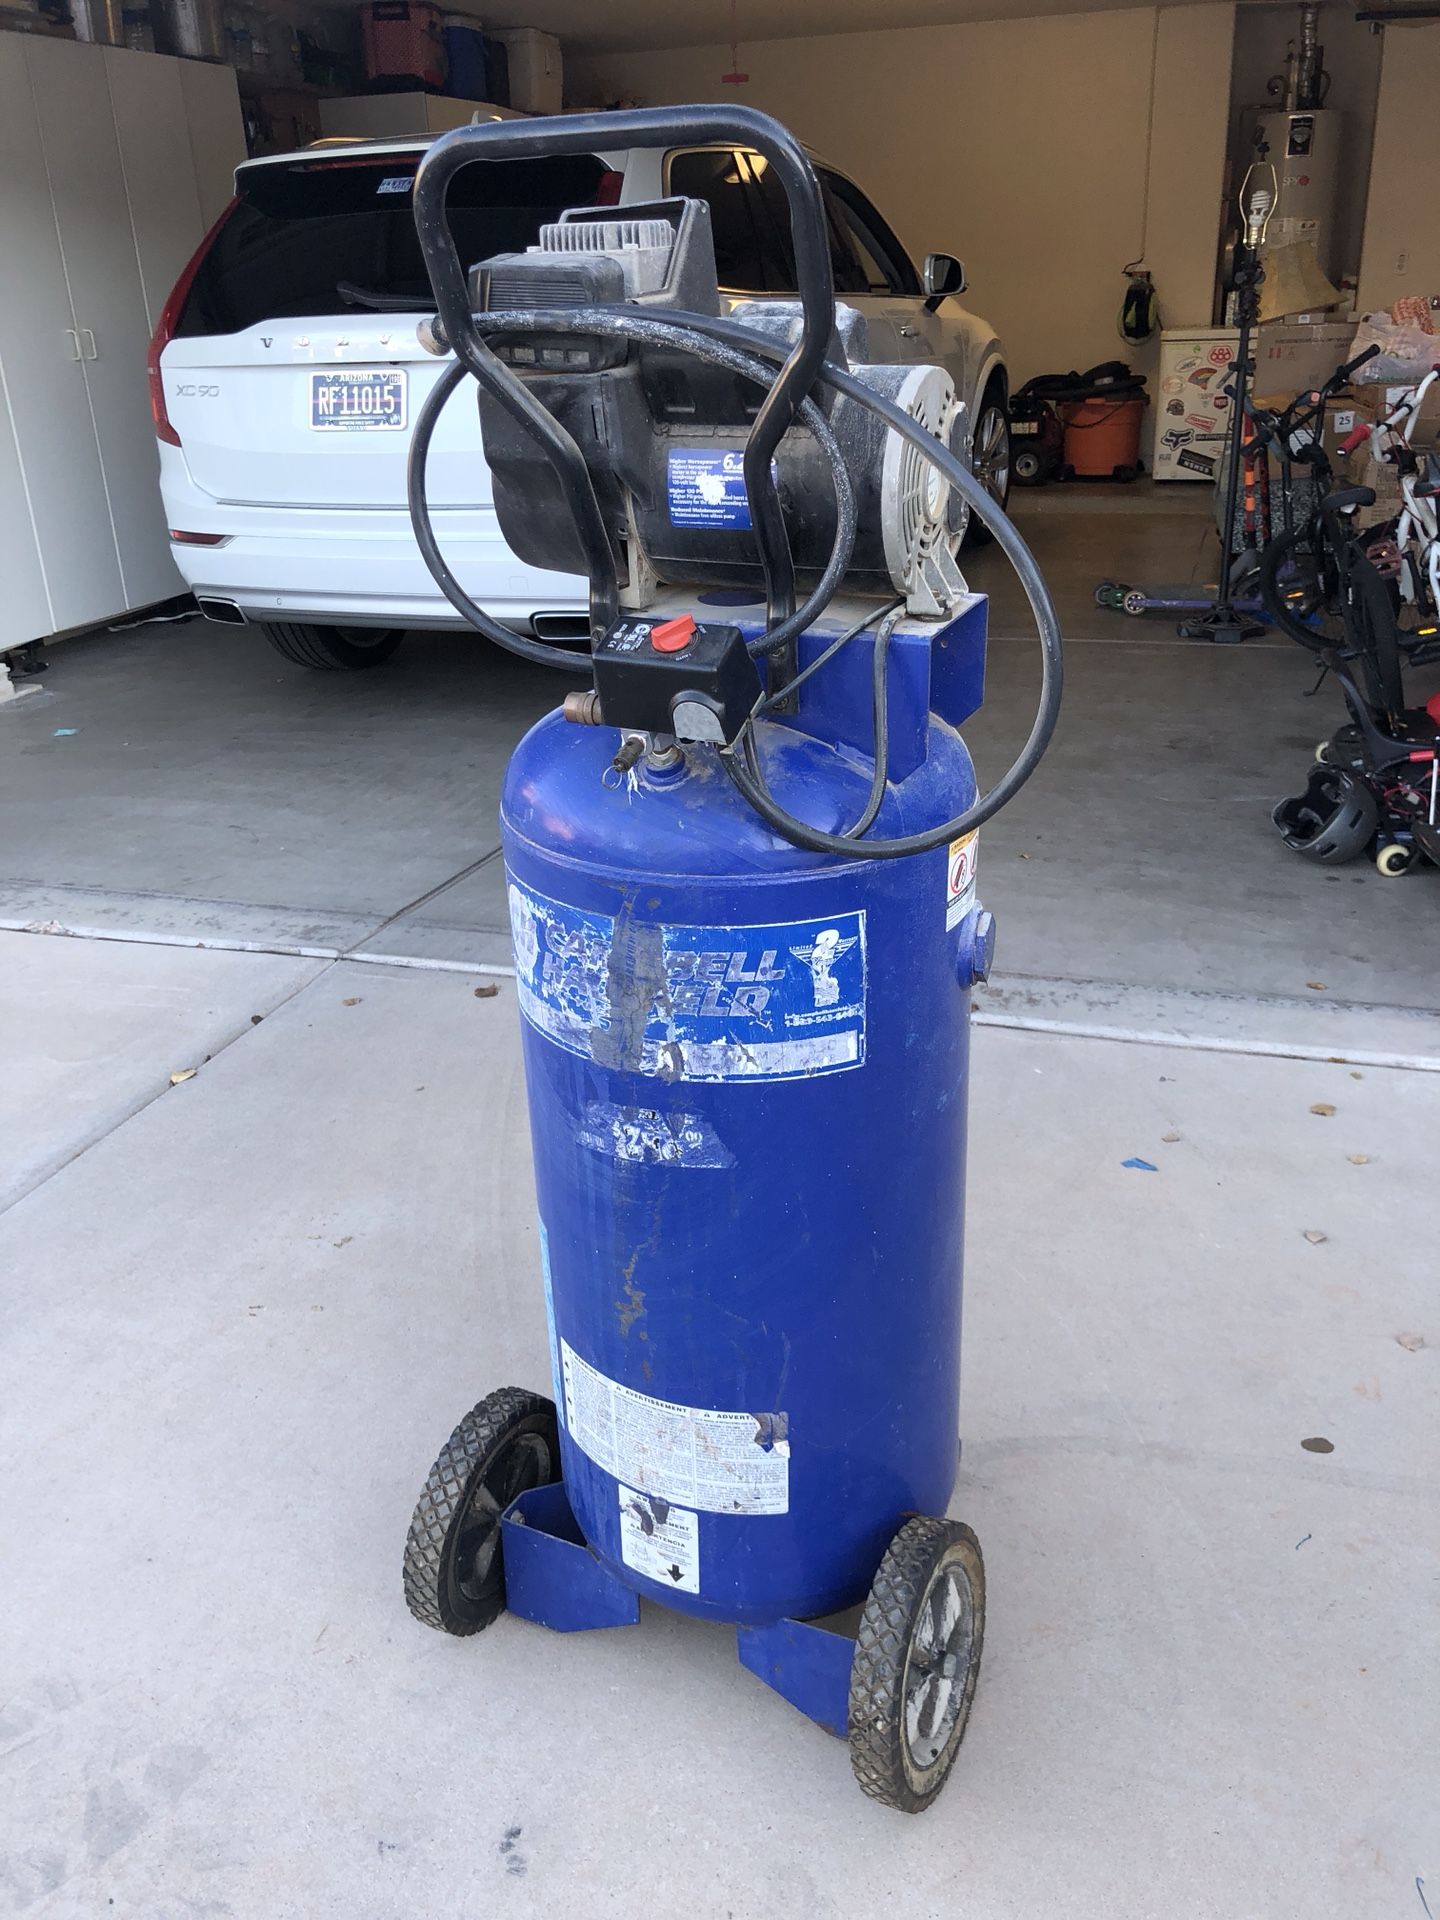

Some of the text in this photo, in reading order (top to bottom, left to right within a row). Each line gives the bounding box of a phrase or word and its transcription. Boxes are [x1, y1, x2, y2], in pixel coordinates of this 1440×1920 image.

[260, 333, 392, 349] VOLV
[339, 374, 374, 383] ARIZONA
[318, 385, 395, 415] RF11015
[1338, 415, 1351, 426] 25
[625, 1389, 688, 1414] AVERTISSEMENT
[716, 1413, 755, 1421] ADVERT
